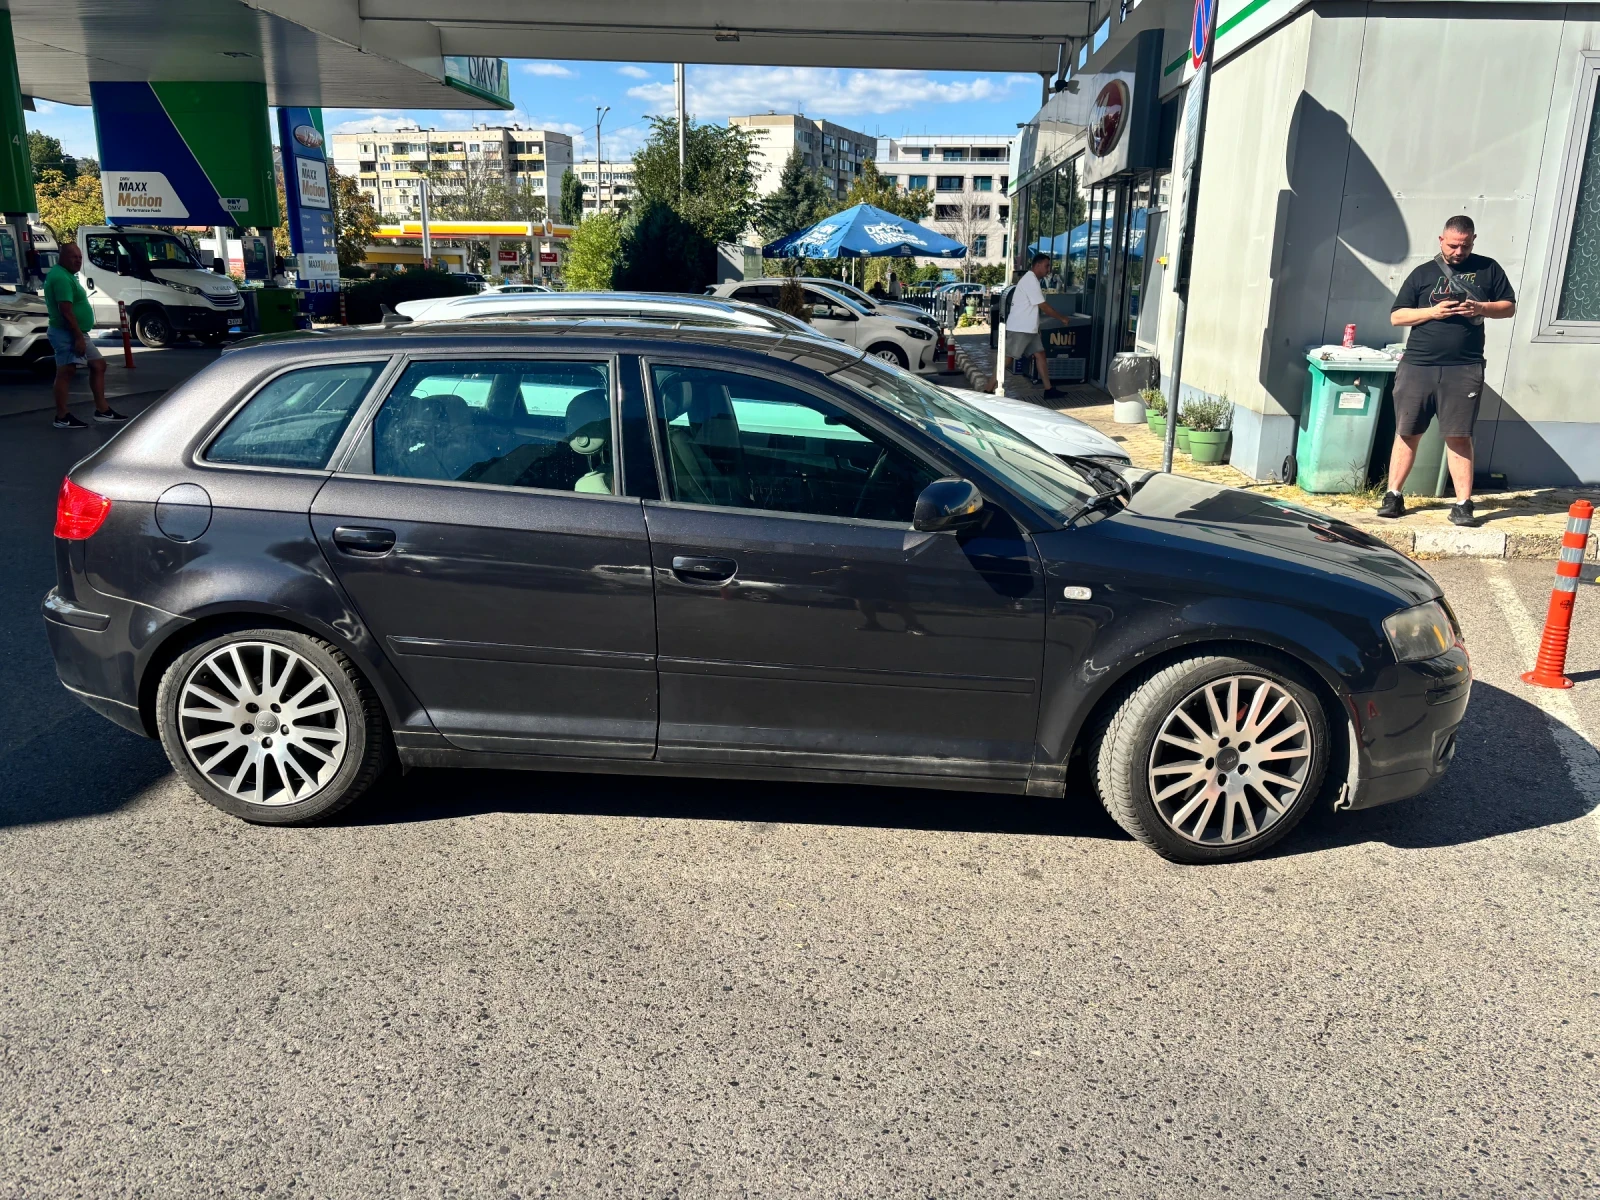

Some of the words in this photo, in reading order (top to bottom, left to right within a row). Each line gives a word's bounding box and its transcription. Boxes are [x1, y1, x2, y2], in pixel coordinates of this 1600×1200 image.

[12, 134, 20, 146] 4
[267, 171, 272, 179] 2
[301, 167, 317, 180] MAXX
[118, 182, 147, 192] MAXX
[302, 180, 326, 198] Motion
[117, 192, 163, 207] Motion
